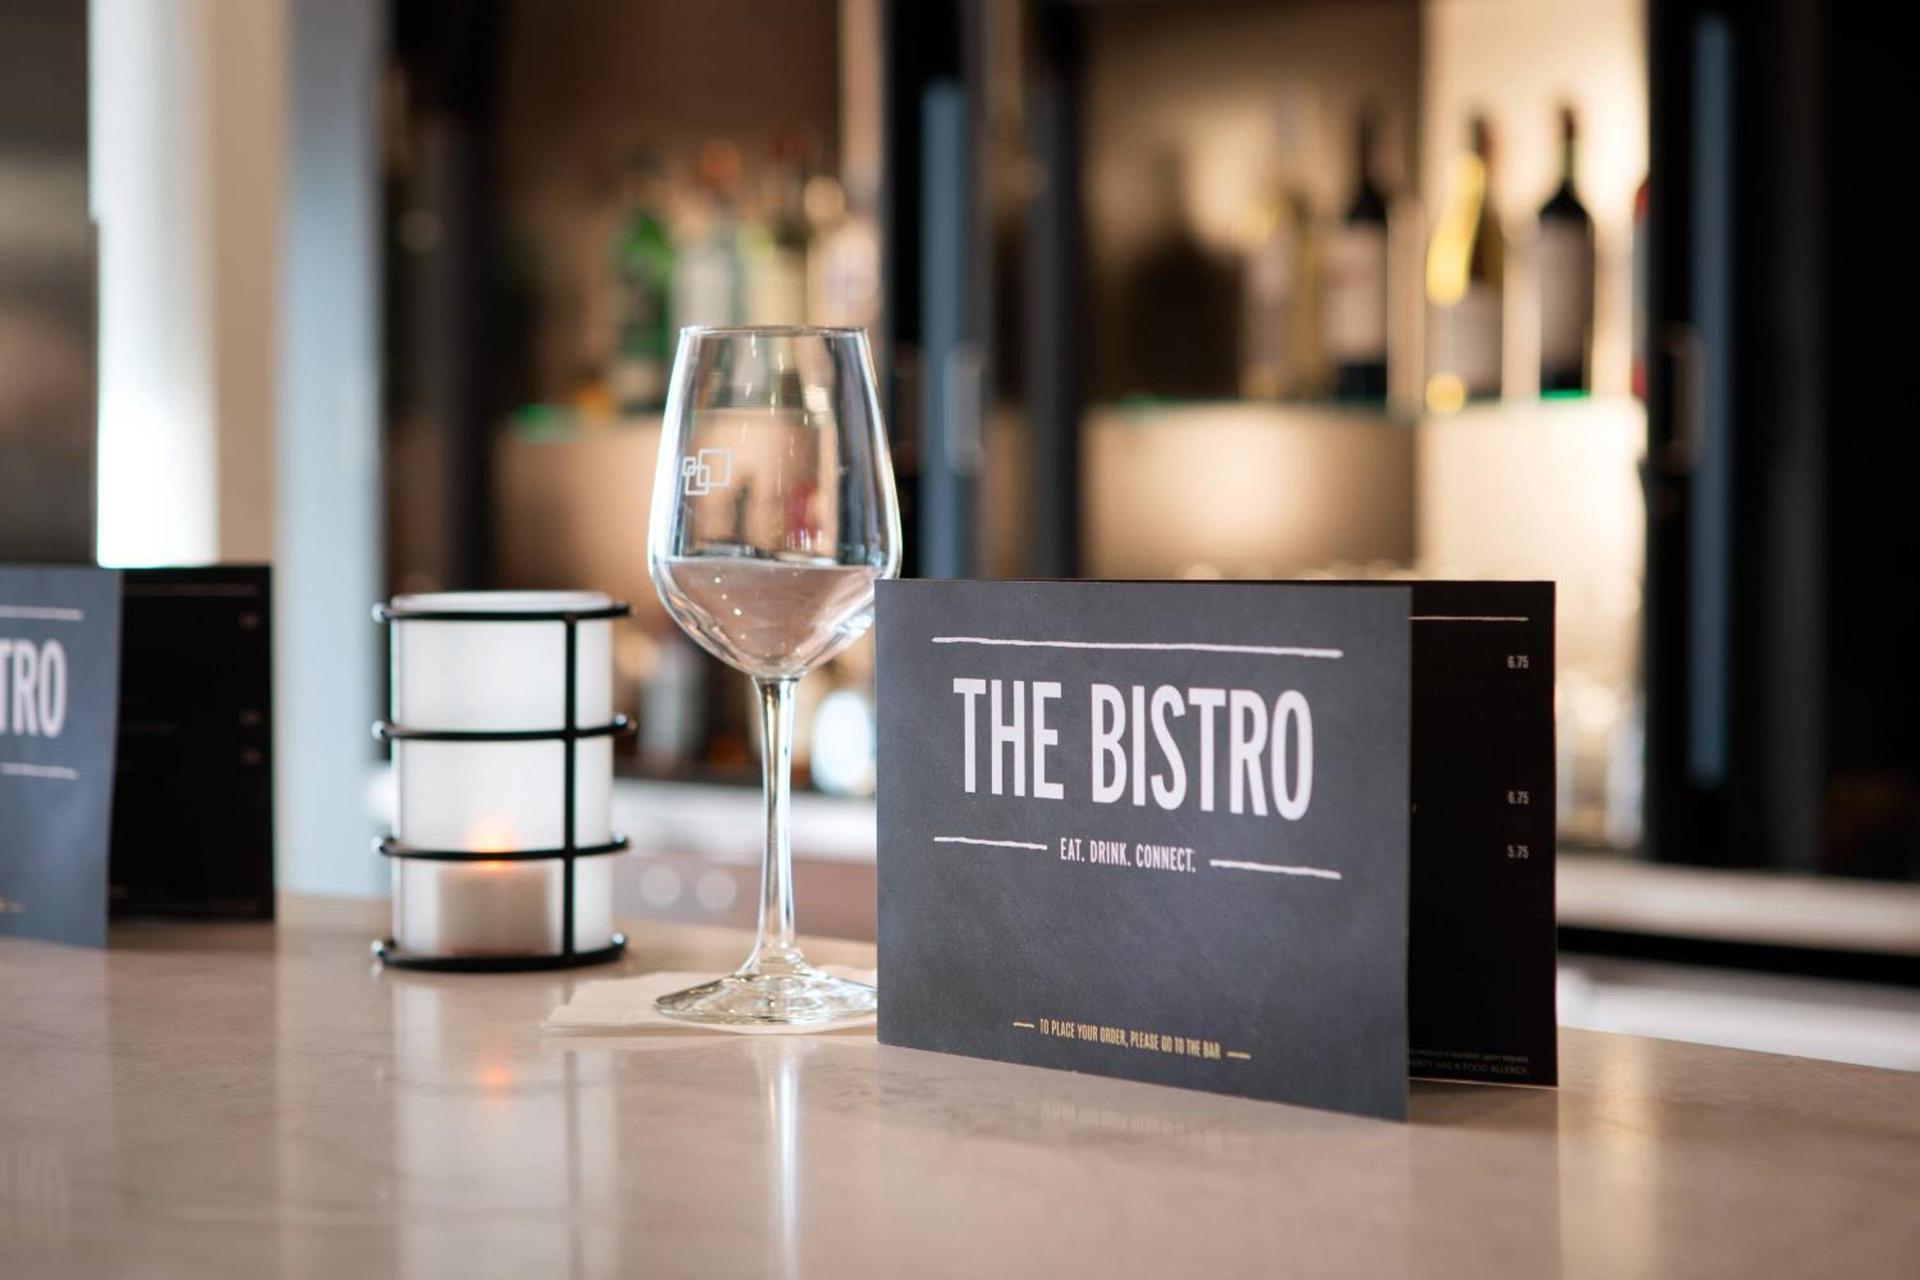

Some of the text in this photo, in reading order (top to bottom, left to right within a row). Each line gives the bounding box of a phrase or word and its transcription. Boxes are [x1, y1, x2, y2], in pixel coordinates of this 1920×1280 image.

[1507, 655, 1530, 669] 6.75
[953, 678, 1314, 821] THE BISTRO
[1060, 837, 1196, 873] EAT. DRINK. CONNECT.
[1507, 845, 1530, 859] 5.75
[1039, 1018, 1222, 1060] TO PLACE YOUR ORDER, PLEASE GO TO THE BAR
